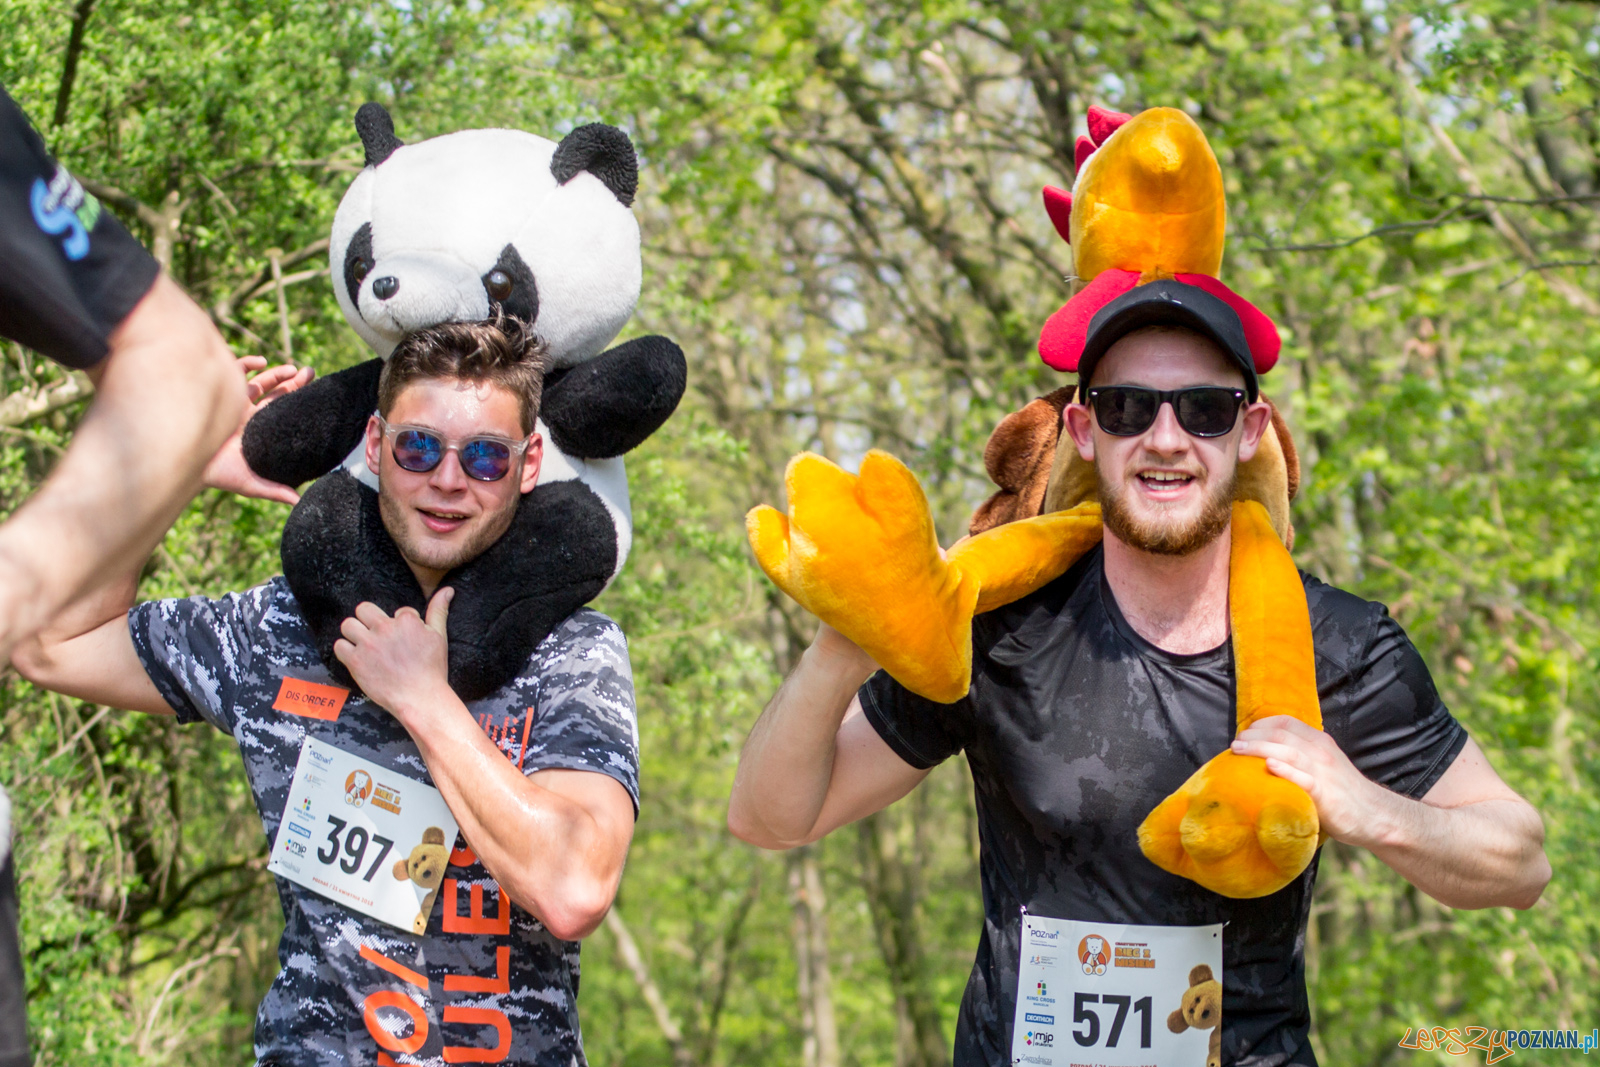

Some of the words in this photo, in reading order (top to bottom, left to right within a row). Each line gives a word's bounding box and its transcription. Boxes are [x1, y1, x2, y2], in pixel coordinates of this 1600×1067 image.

[292, 841, 307, 854] mjp
[317, 814, 395, 883] 397
[1114, 947, 1141, 958] BIEG
[1114, 958, 1156, 969] MISIEM
[1040, 996, 1056, 1004] CROSS
[1072, 991, 1152, 1049] 571
[1035, 1032, 1054, 1044] mjp
